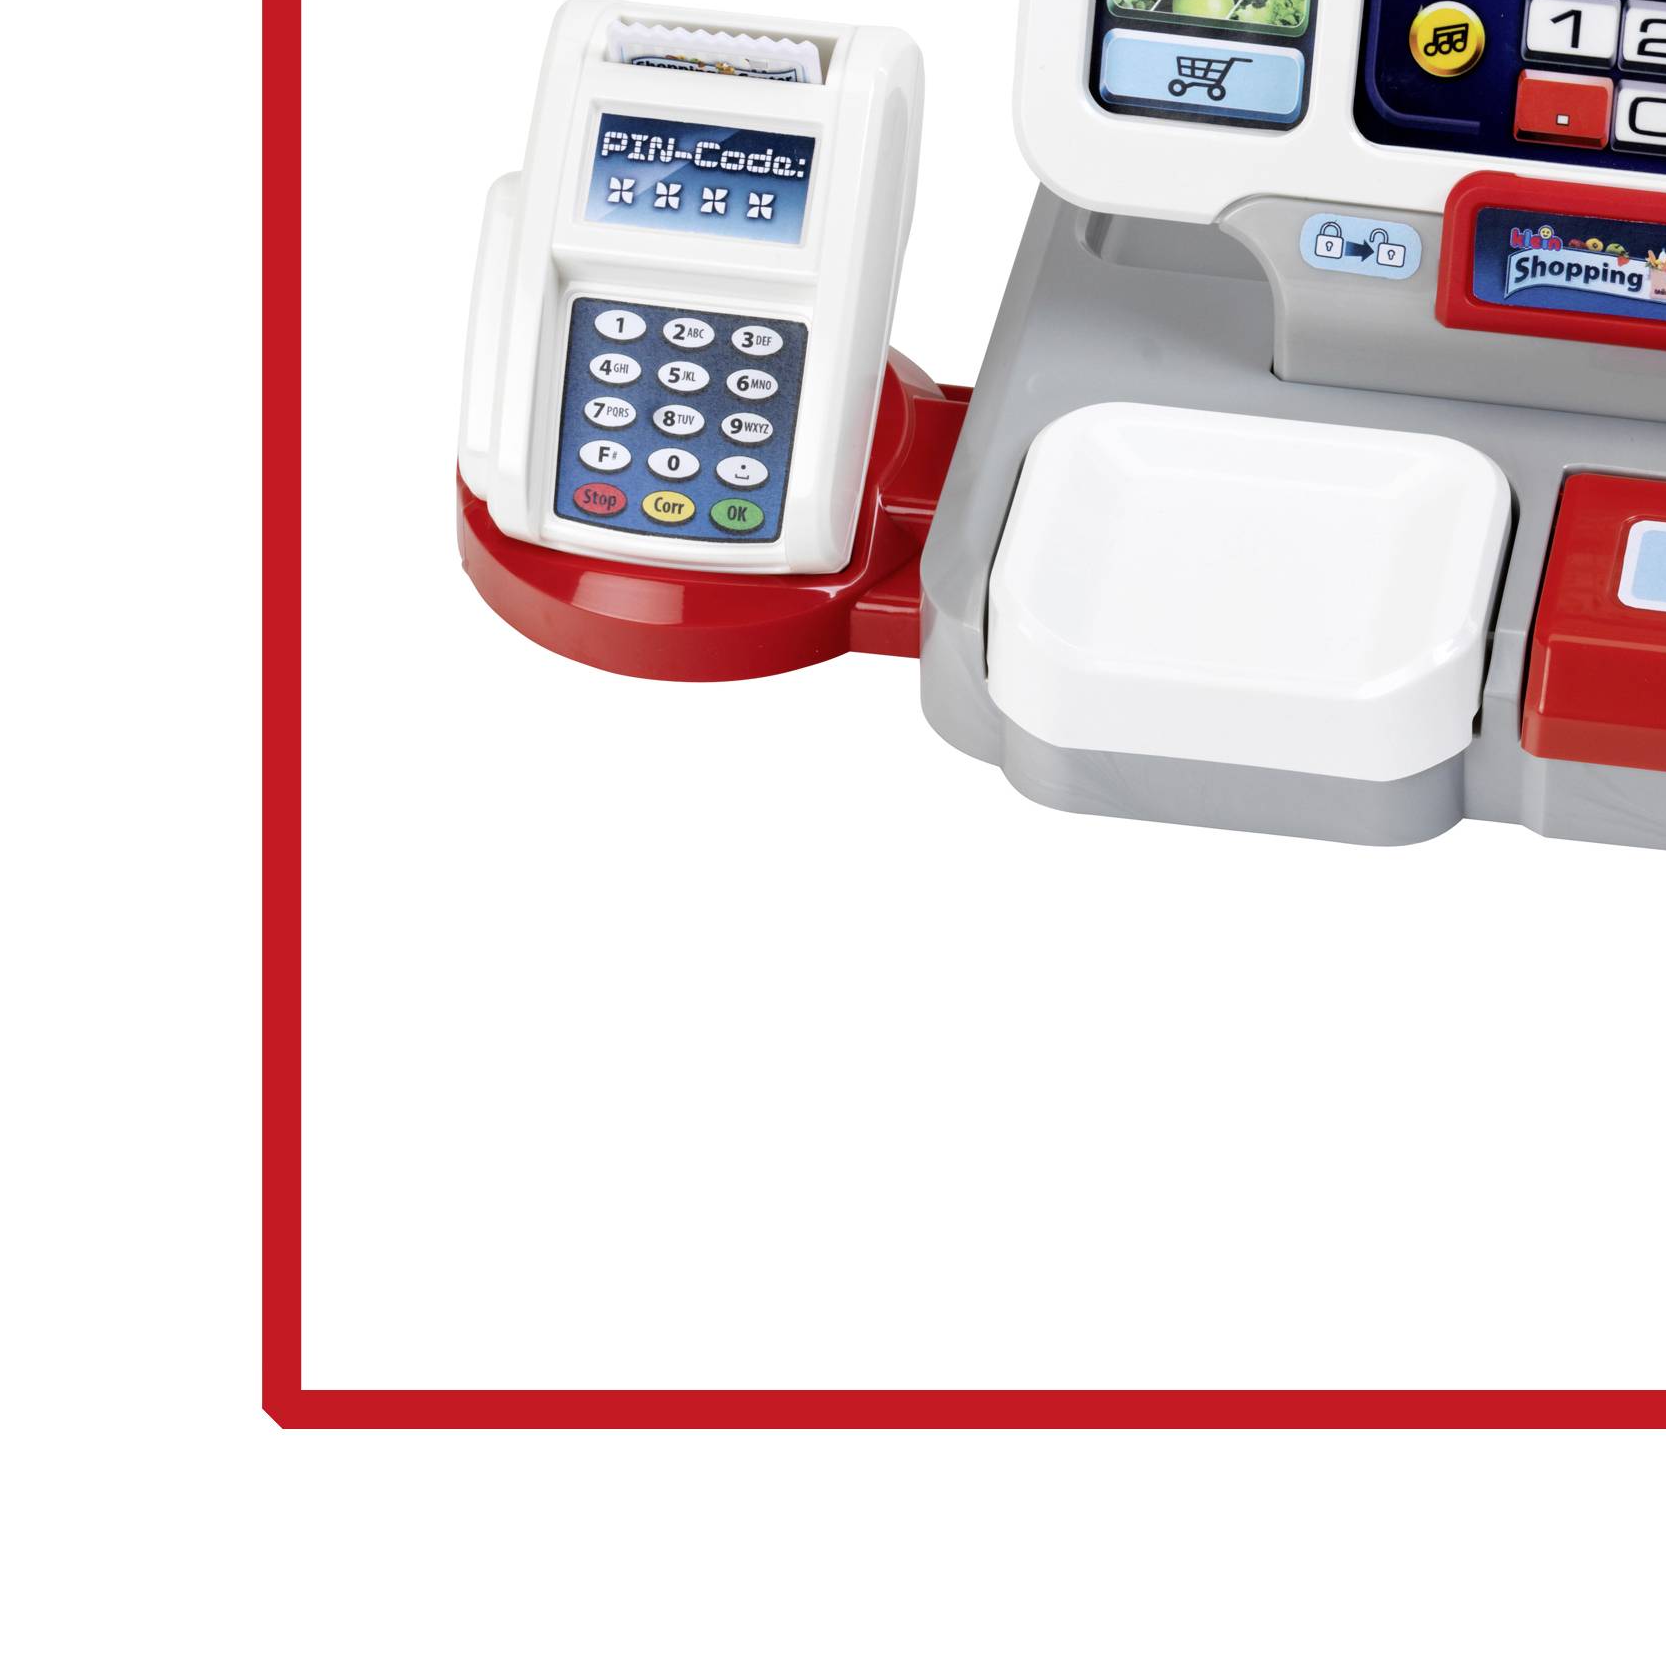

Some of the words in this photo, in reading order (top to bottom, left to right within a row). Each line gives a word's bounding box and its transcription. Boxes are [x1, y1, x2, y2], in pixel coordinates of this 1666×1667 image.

[1550, 9, 1582, 49] 1
[601, 131, 805, 178] PIN-Code:
[1514, 255, 1644, 292] Shopping
[615, 317, 625, 334] 1
[583, 489, 617, 509] Stop
[654, 497, 685, 515] Corr
[727, 505, 747, 523] OK
